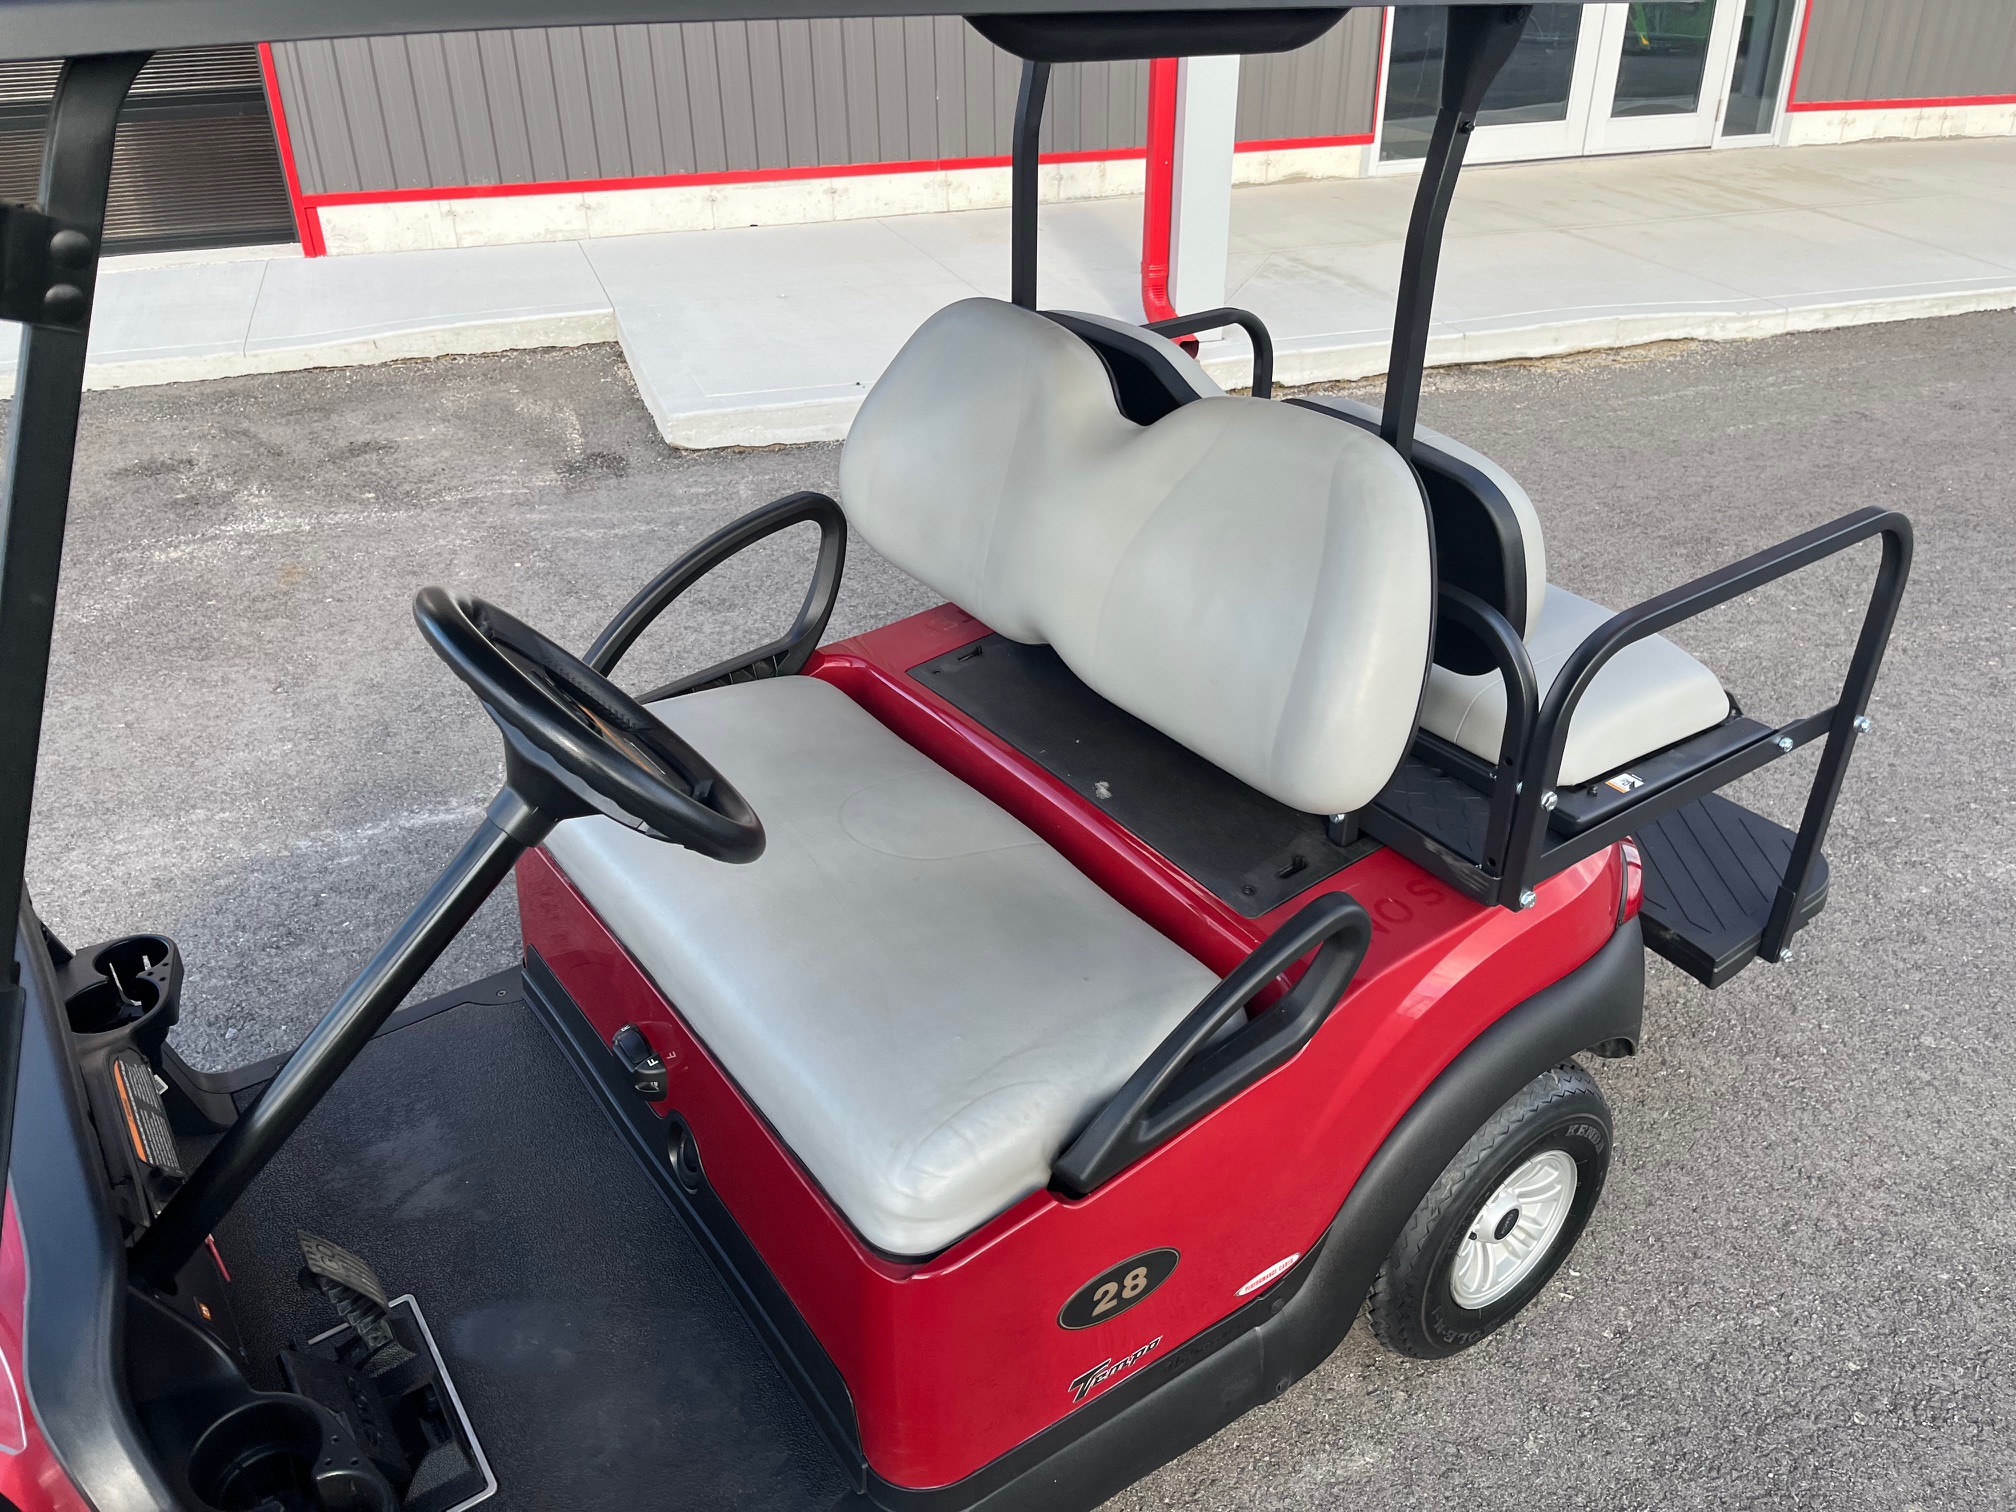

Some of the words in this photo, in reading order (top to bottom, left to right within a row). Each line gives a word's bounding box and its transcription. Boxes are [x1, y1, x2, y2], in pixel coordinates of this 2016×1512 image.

[647, 1058, 658, 1066] F
[1564, 1123, 1606, 1155] KENDA
[316, 1243, 339, 1270] GO
[1092, 1266, 1148, 1317] 28
[1067, 1334, 1164, 1404] Tempo
